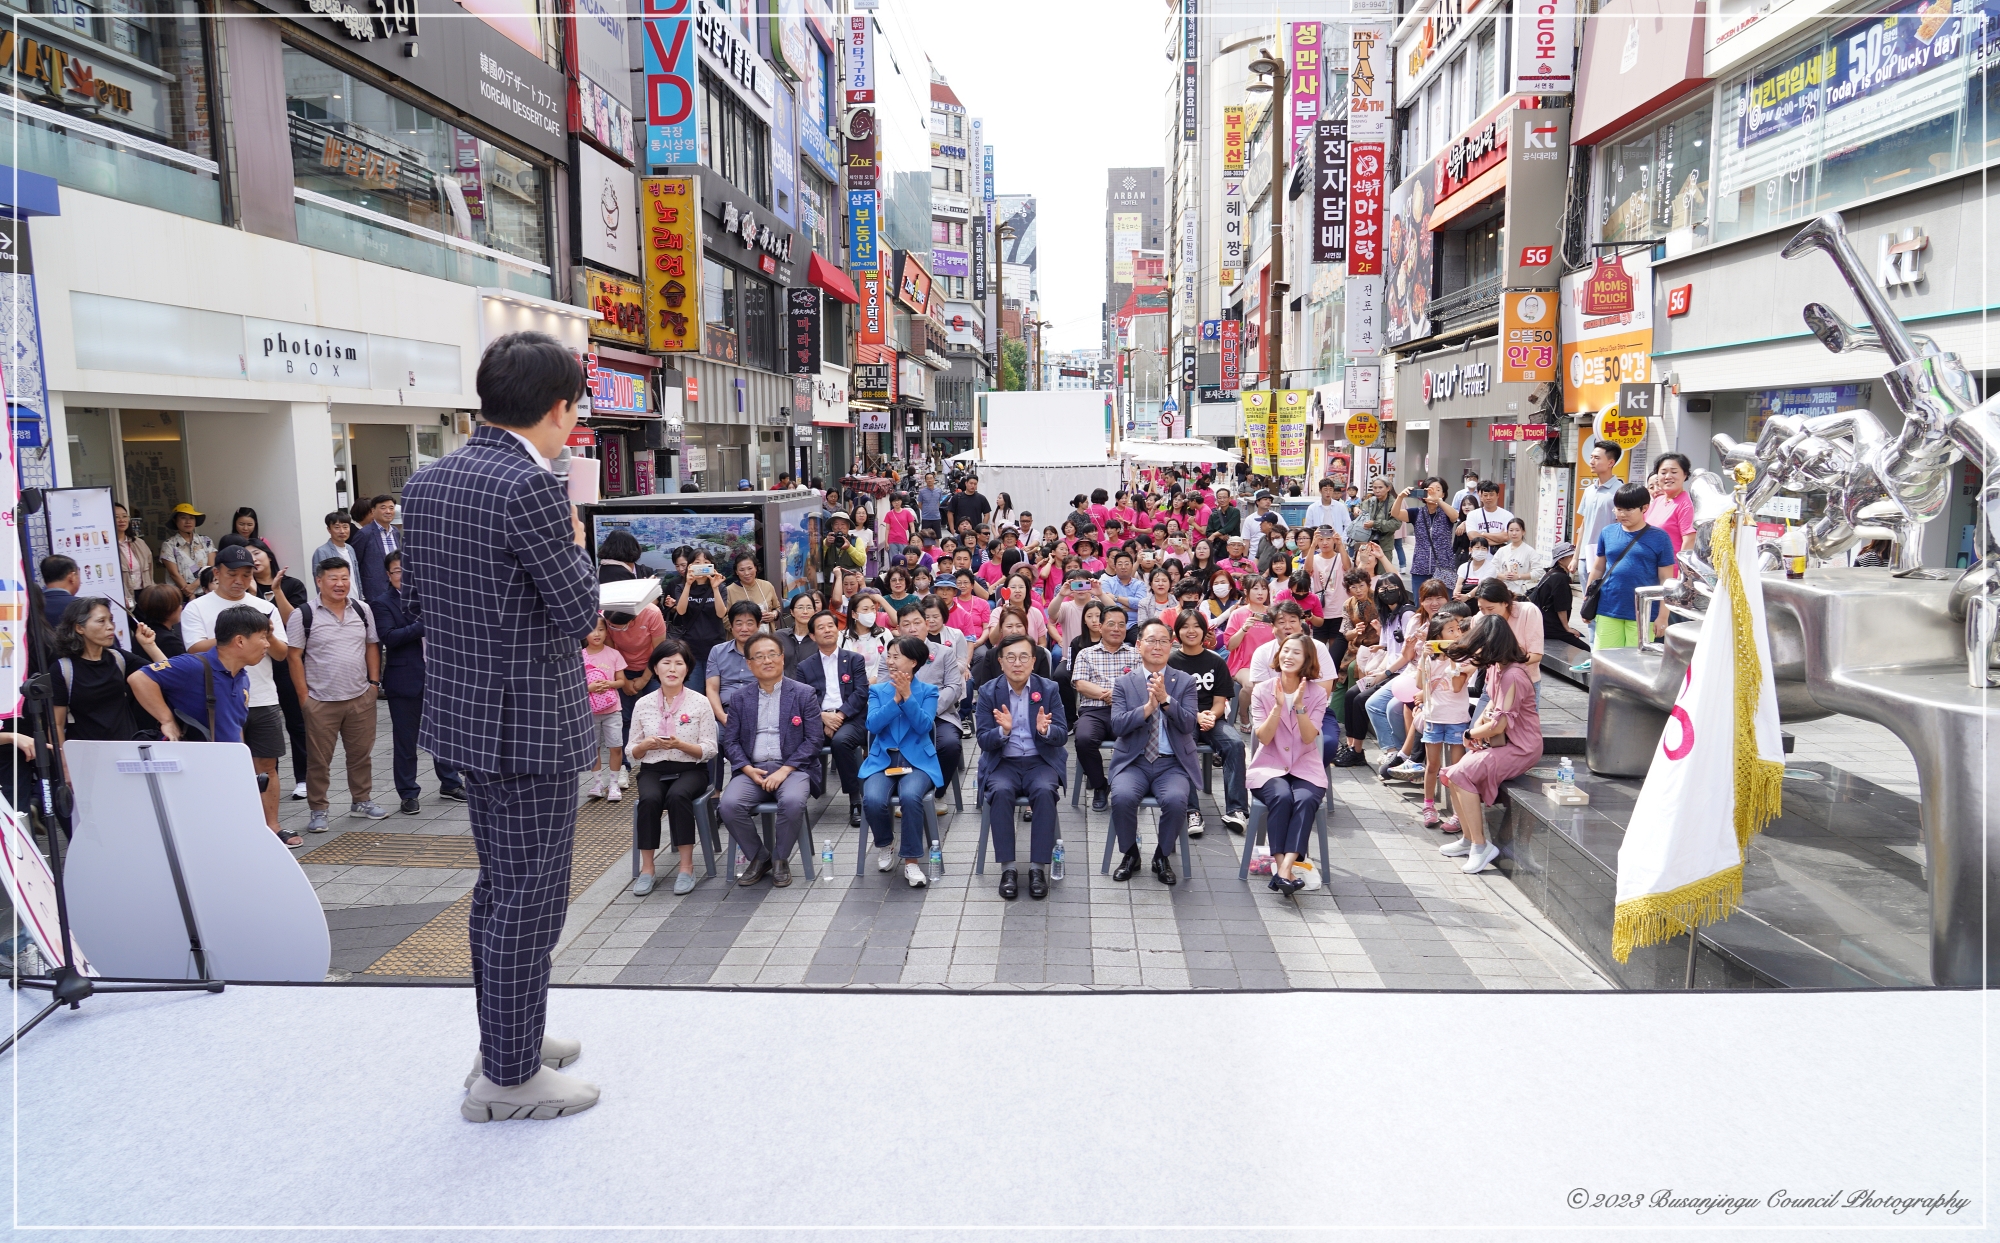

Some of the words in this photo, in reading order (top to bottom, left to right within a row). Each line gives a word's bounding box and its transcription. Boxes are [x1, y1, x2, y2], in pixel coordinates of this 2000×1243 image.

[1716, 28, 1735, 45] CHICKEN
[852, 32, 866, 87] 짱탁구장
[1351, 40, 1374, 96] TAN
[1826, 80, 1857, 104] Today
[1861, 74, 1871, 89] is
[1875, 62, 1894, 82] our
[1898, 45, 1930, 73] lucky
[1934, 32, 1961, 58] day
[480, 51, 558, 113] 韓國のデザートカフェ
[853, 91, 866, 101] 4F
[1186, 76, 1195, 117] 한솔요리
[1351, 98, 1384, 112] 24TH
[480, 80, 511, 110] KOREAN
[512, 101, 543, 128] DESSERT
[543, 114, 561, 137] CAFE
[1760, 109, 1774, 124] PM
[661, 127, 683, 138] 극장
[1226, 115, 1242, 163] 부동산
[1524, 121, 1557, 148] kt
[651, 139, 694, 151] 통시상영
[665, 152, 681, 163] 3F
[850, 154, 872, 167] ZONE
[1522, 152, 1558, 161] 공식대리점
[851, 194, 873, 206] 삼주
[1321, 140, 1346, 248] 전자담배
[855, 209, 872, 258] 부동산
[1226, 201, 1241, 256] 헤어짱
[1354, 199, 1378, 260] 마라탕
[976, 226, 984, 290] 퍼스트바리스타학원
[1526, 249, 1546, 264] 5G
[1878, 226, 1928, 287] kt
[652, 200, 688, 336] 노래연습장
[1358, 262, 1372, 273] 2F
[865, 281, 880, 333] 짱오락실
[1593, 291, 1628, 304] TOUCH
[1670, 290, 1684, 310] 5G
[1362, 284, 1373, 344] 전포여관
[797, 317, 811, 364] 마라탕
[1509, 330, 1552, 343] 으뜸50
[263, 332, 357, 361] photoism
[1224, 340, 1237, 378] 마라탕
[1507, 346, 1552, 368] 안경
[286, 360, 340, 377] BOX
[857, 366, 888, 376] 싸대기
[1184, 357, 1194, 383] PC
[1524, 371, 1535, 379] B1
[1584, 351, 1646, 385] 으뜸50안경
[614, 375, 634, 409] DVD
[857, 378, 888, 388] 중고폰
[1463, 381, 1484, 395] STORE
[1626, 391, 1649, 409] kt
[1812, 392, 1837, 404] 가입하면
[862, 422, 887, 430] 혼술남녀
[1348, 423, 1378, 433] 부동산
[1525, 428, 1544, 436] TOUCH
[1604, 419, 1643, 437] 부동산
[1280, 448, 1304, 456] 절대금지
[42, 779, 53, 814] SAMSON
